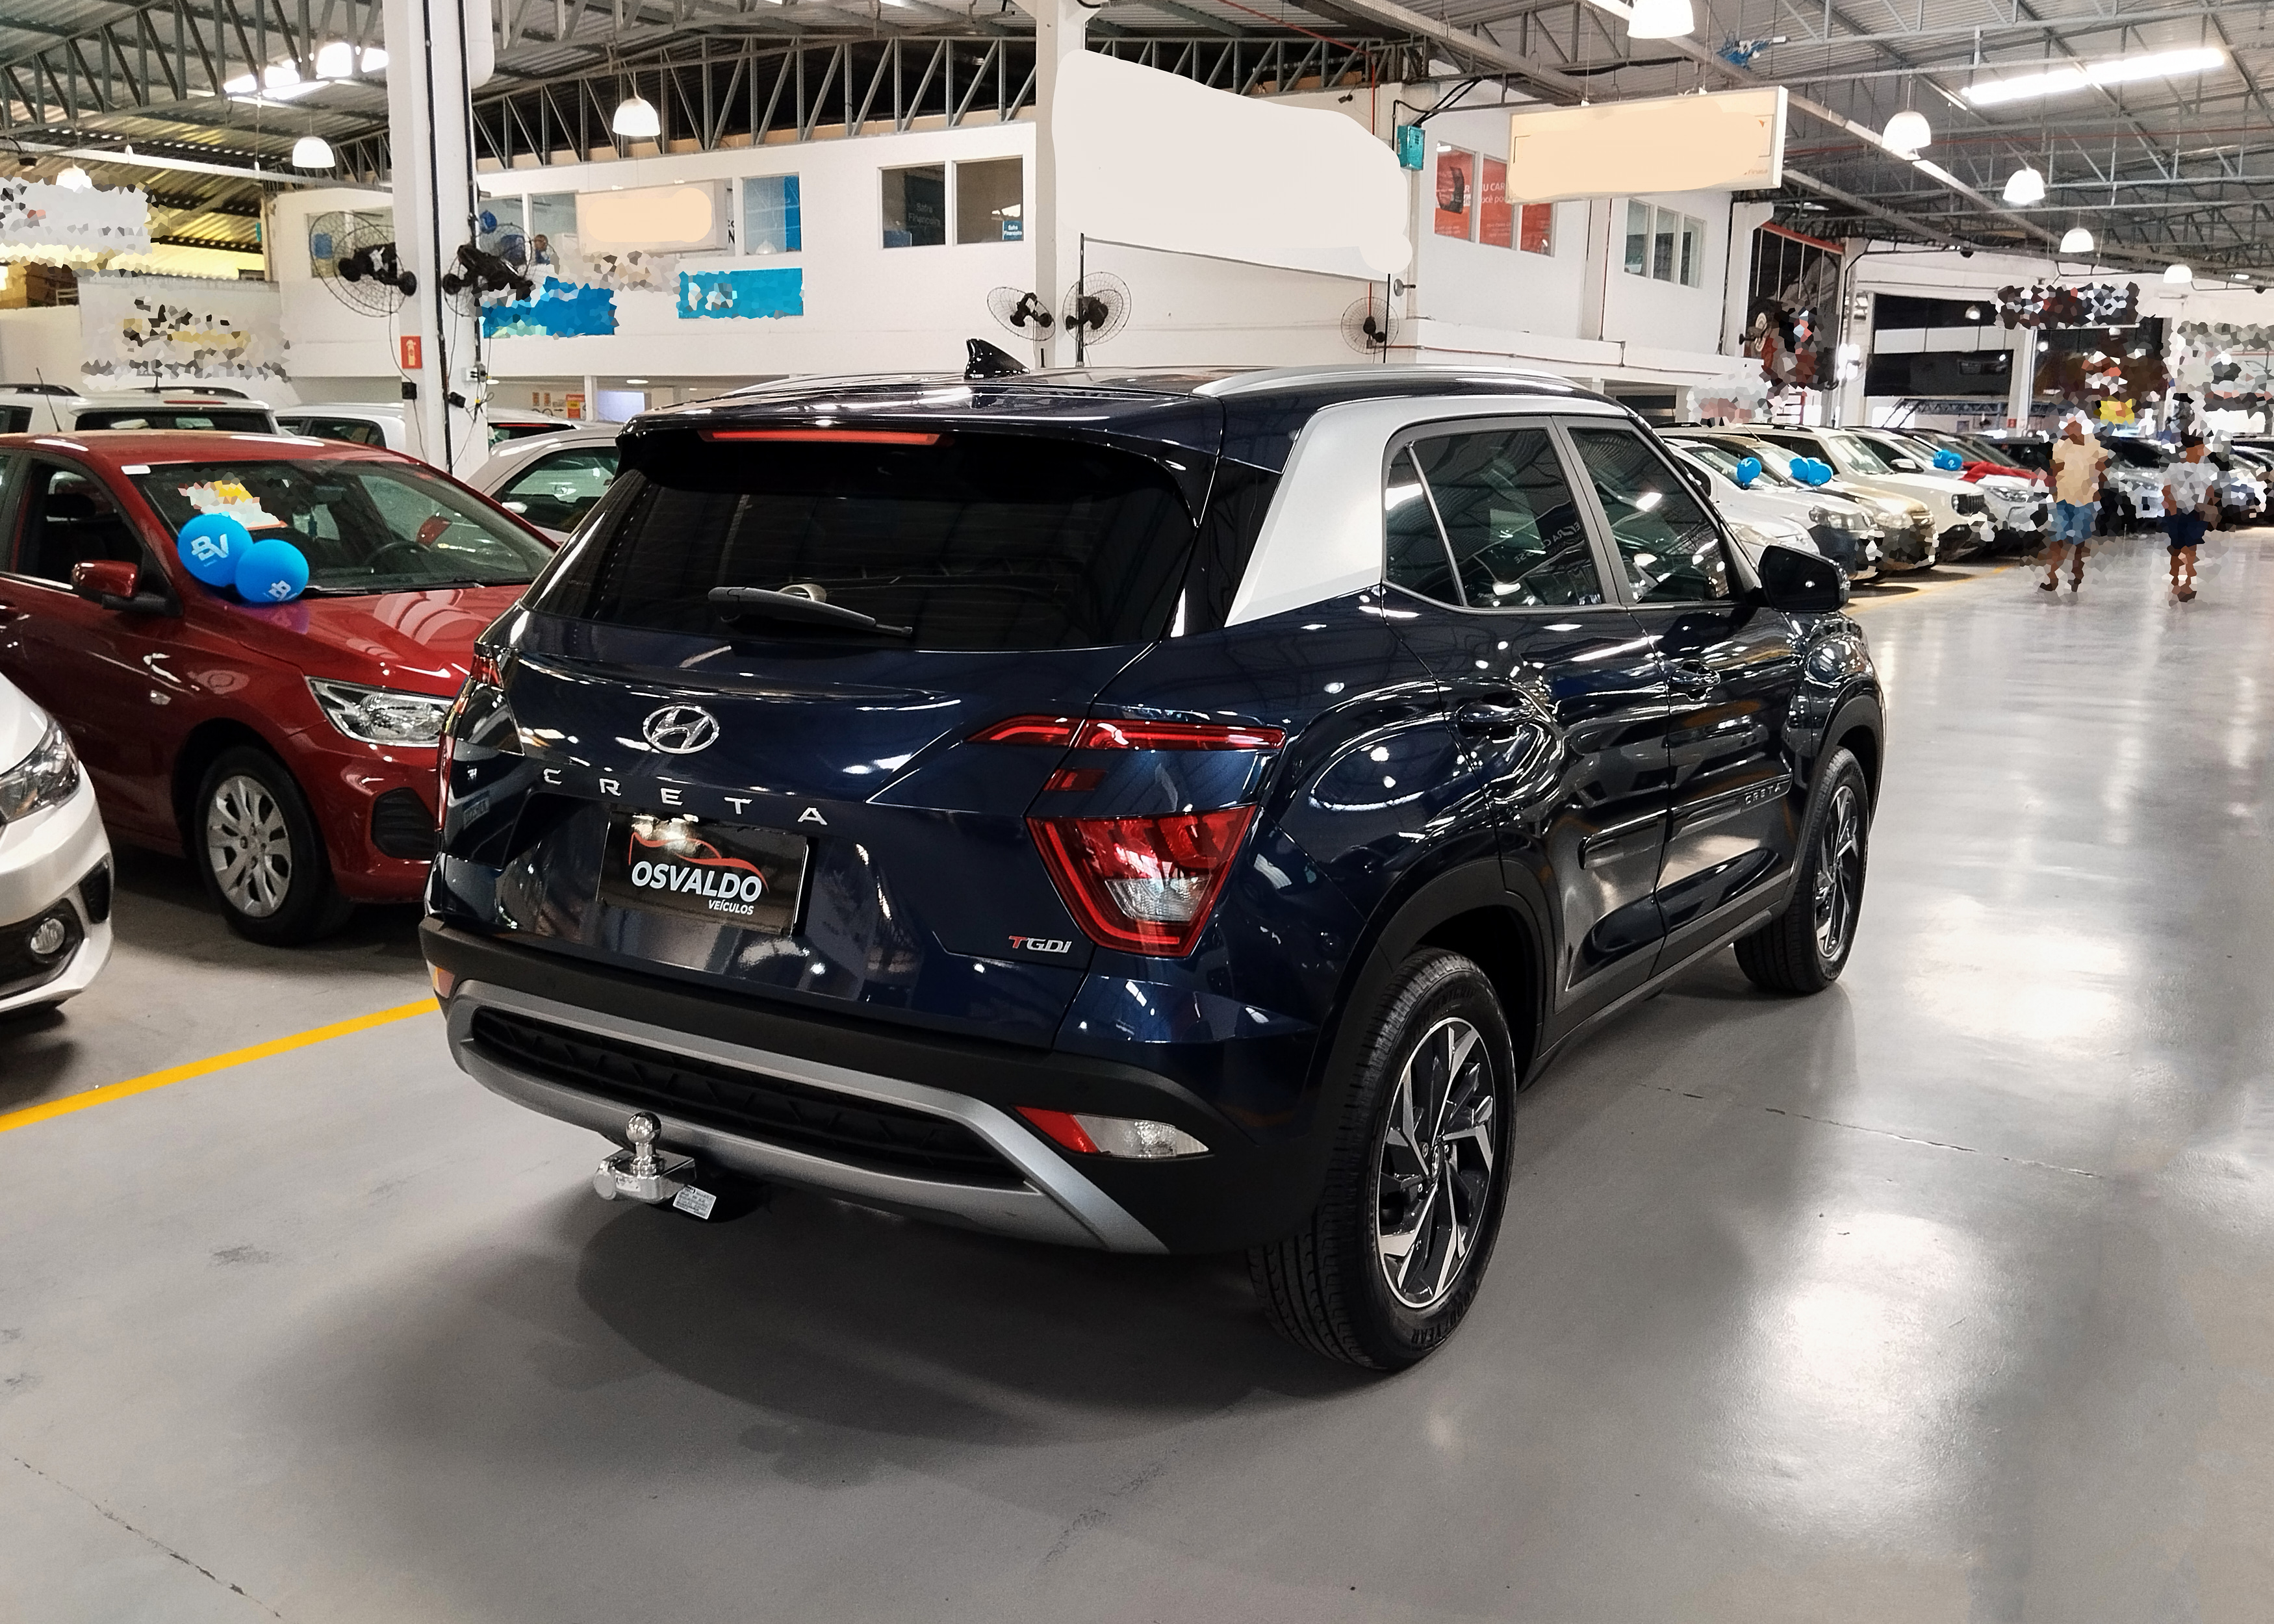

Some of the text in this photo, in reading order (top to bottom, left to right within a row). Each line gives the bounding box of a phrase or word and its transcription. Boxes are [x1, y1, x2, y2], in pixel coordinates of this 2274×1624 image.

[191, 533, 229, 561] BV
[543, 768, 828, 826] CRETA
[632, 860, 762, 902] OSVALDO
[708, 898, 754, 916] VEÍCULOS
[1008, 935, 1073, 954] TGDI
